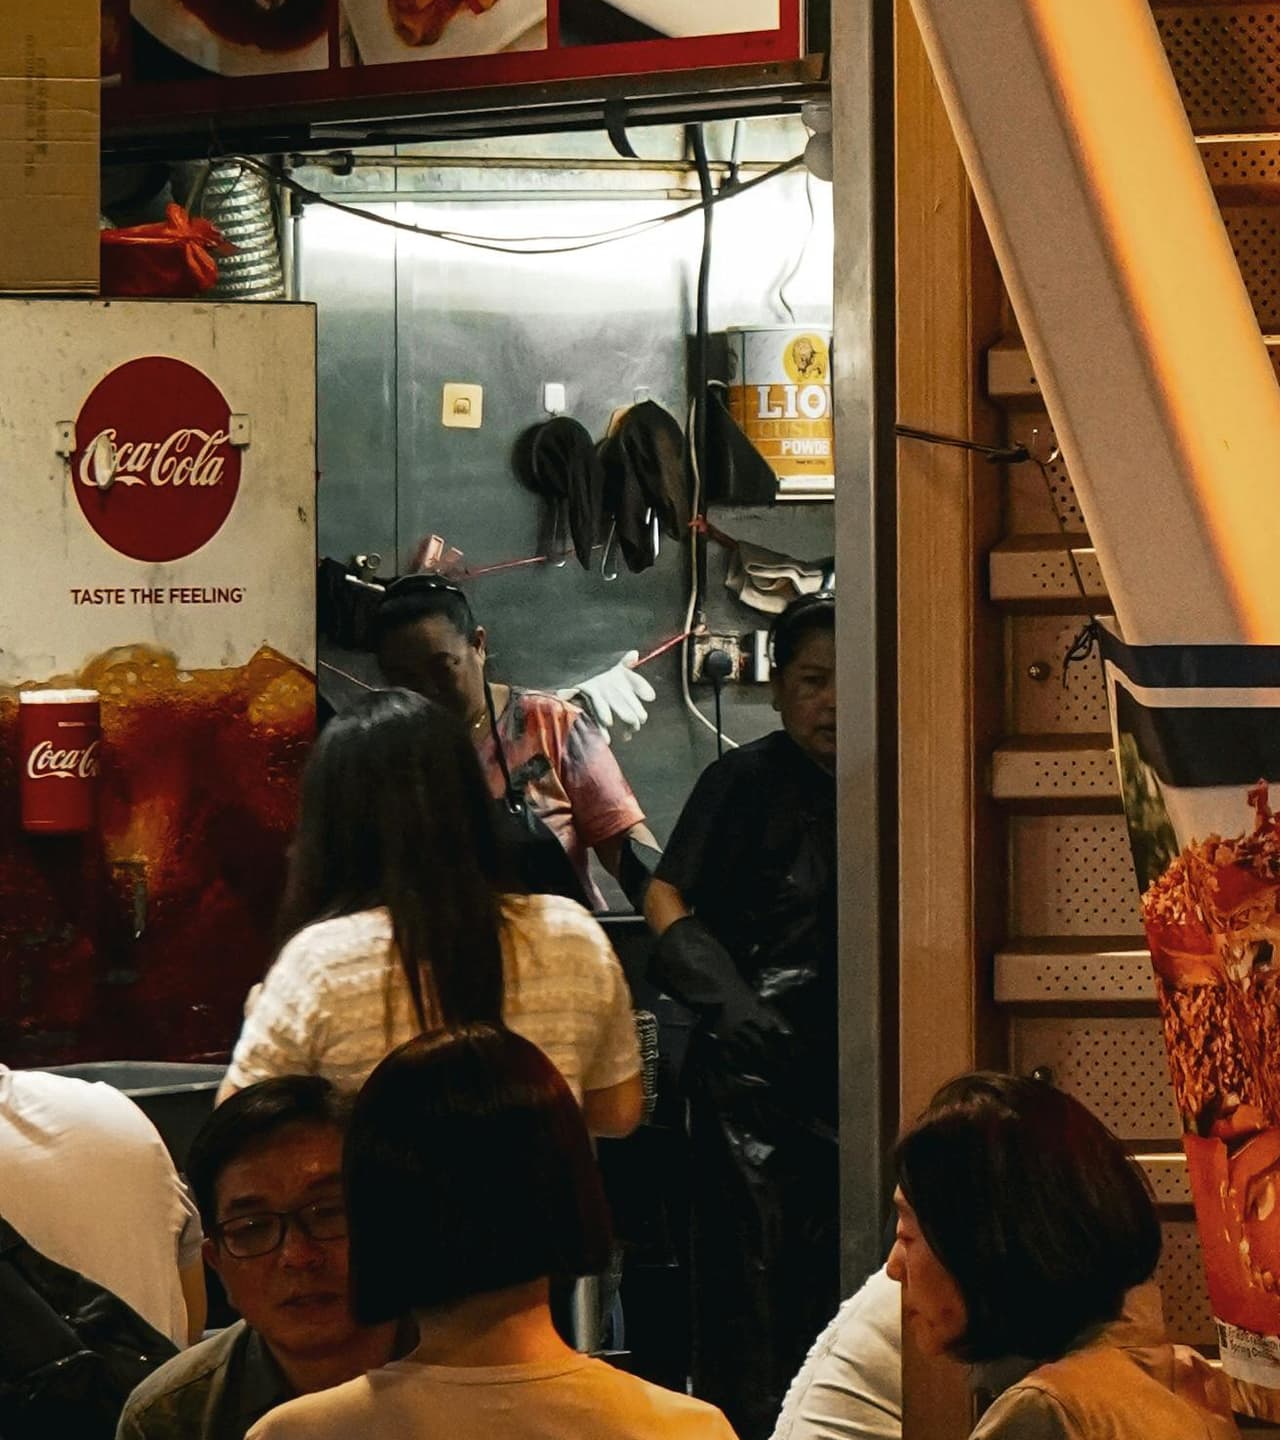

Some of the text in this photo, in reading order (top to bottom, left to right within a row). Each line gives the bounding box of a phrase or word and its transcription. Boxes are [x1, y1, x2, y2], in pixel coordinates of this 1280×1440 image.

[757, 384, 830, 419] LIO
[79, 427, 231, 489] Coca-Cola
[70, 587, 243, 605] TASTE THE FEELING
